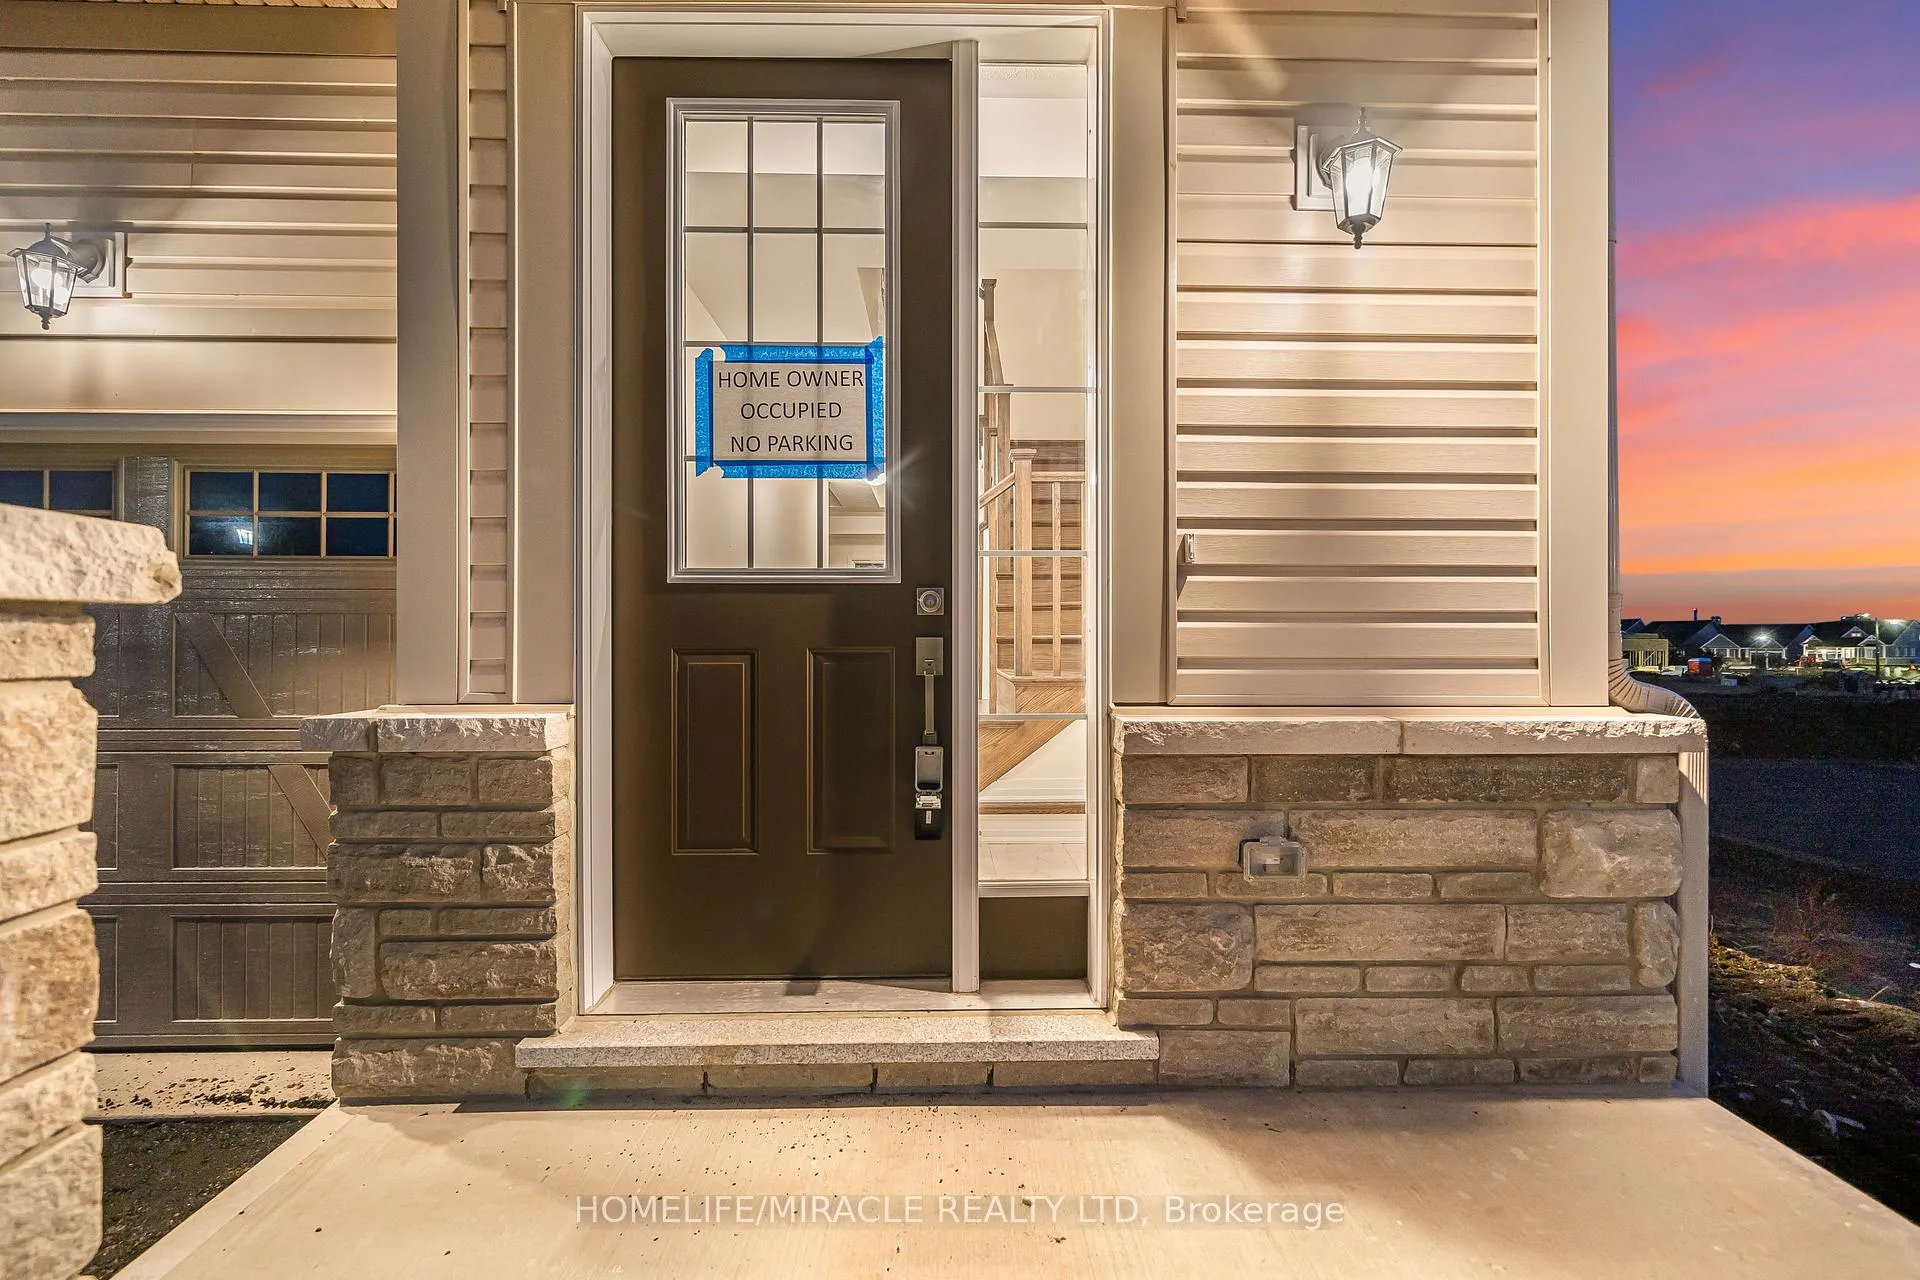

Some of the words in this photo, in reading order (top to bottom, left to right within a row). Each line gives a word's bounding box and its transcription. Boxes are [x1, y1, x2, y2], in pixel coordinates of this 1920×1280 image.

[718, 371, 780, 388] HOME
[787, 370, 864, 387] OWNER
[740, 402, 842, 419] OCCUPIED
[731, 436, 761, 452] NO
[768, 434, 853, 452] PARKING
